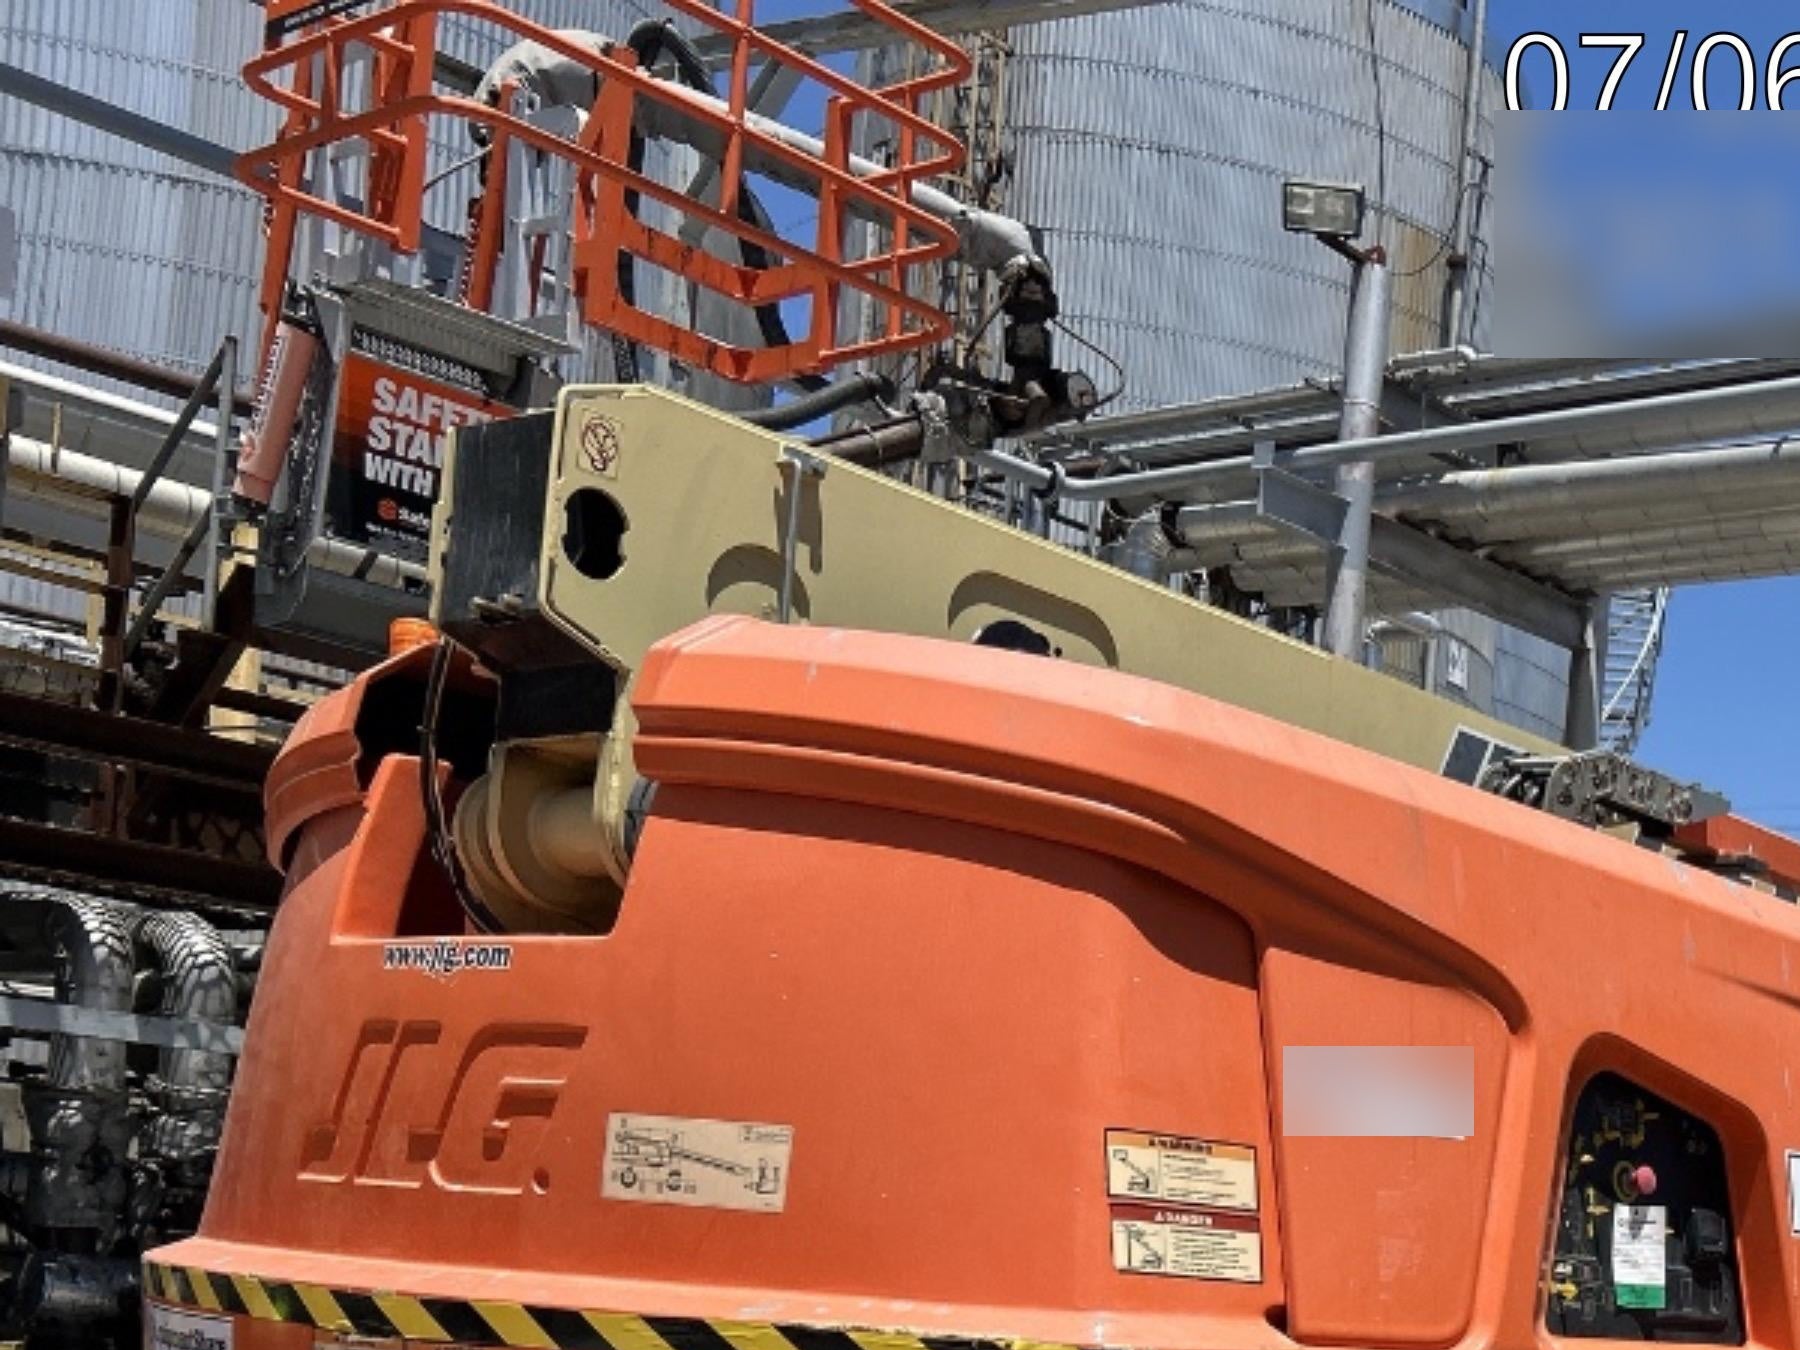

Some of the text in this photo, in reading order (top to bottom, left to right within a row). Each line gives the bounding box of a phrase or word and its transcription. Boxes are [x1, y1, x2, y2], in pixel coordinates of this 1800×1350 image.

[371, 377, 500, 431] SAFET
[364, 451, 433, 497] WITH
[384, 941, 512, 973] www.jlg.com
